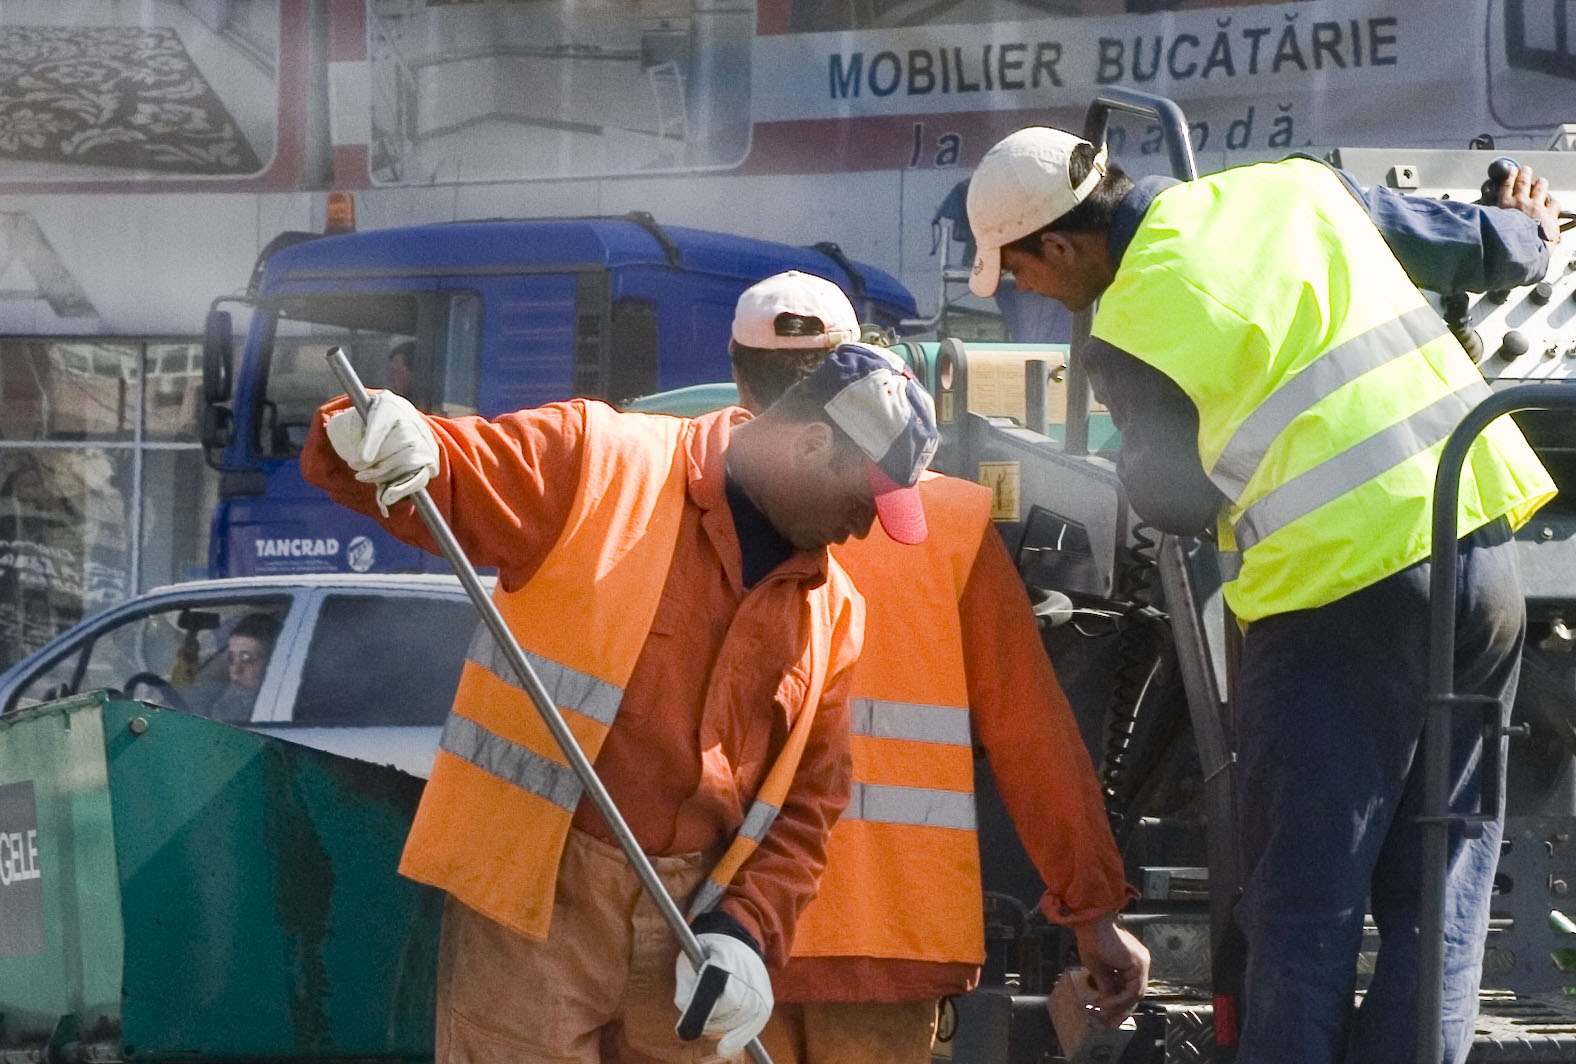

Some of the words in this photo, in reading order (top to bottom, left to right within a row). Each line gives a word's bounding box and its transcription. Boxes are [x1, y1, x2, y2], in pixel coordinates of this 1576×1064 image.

[829, 41, 1064, 99] MOBILIER
[1096, 13, 1399, 84] BUCĂTĂRIE
[910, 121, 962, 168] la
[255, 538, 340, 557] TANCRAD
